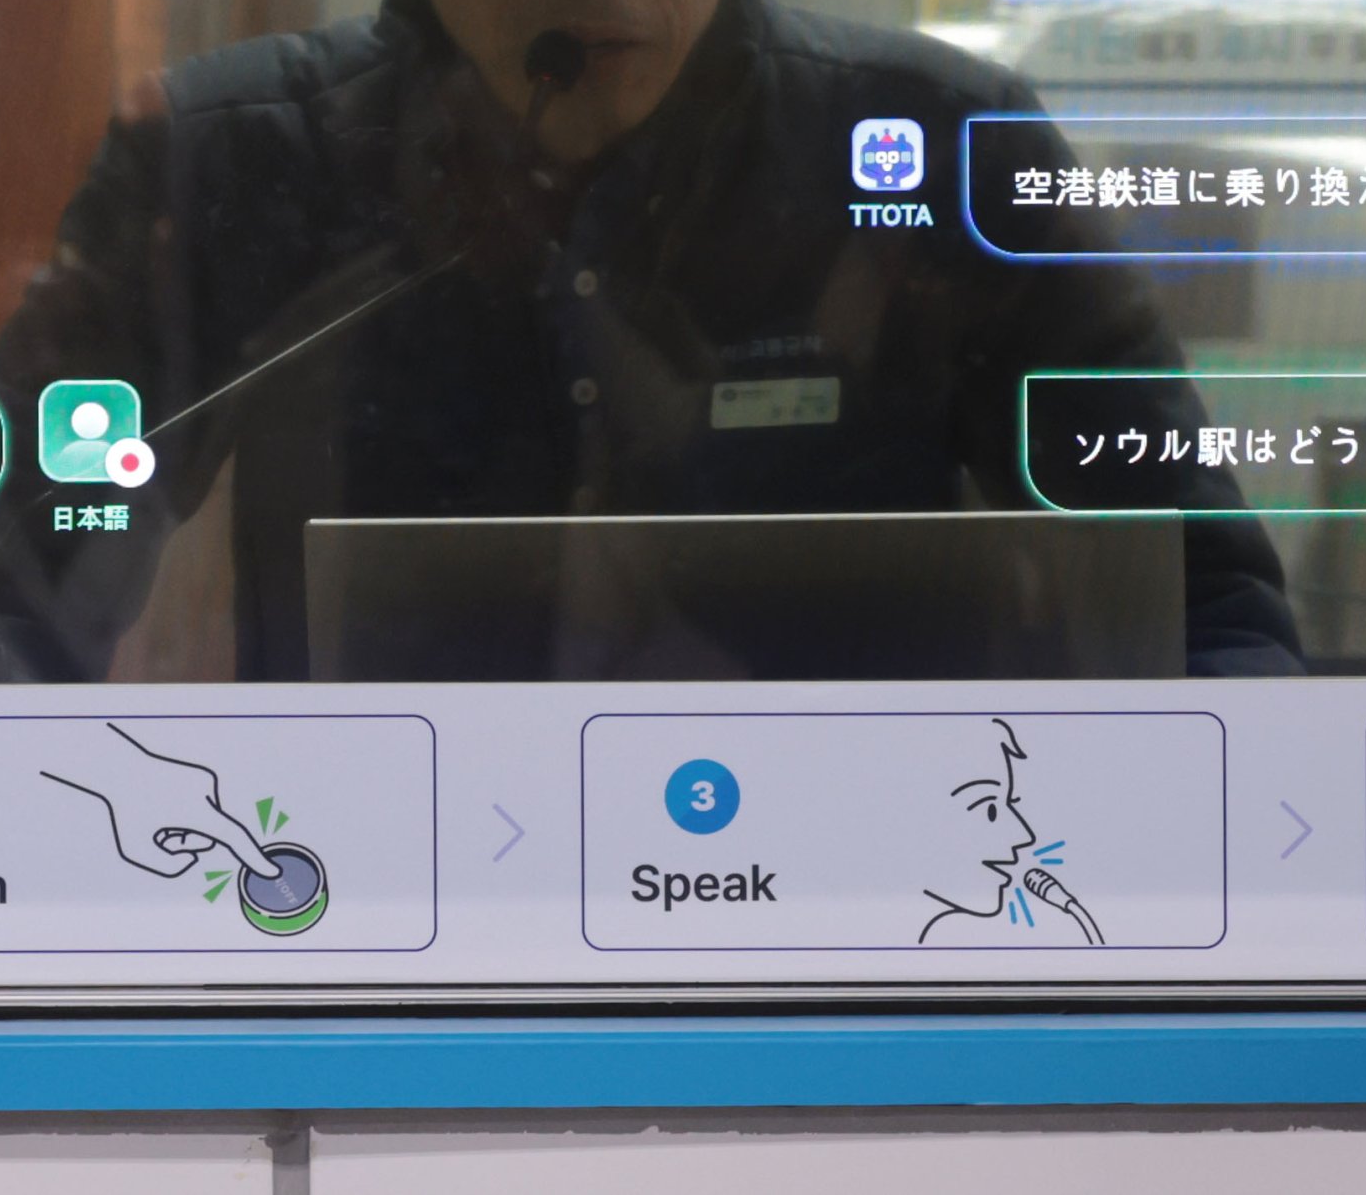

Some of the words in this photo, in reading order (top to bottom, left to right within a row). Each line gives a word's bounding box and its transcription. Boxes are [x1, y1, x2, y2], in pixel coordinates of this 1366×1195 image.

[849, 204, 933, 226] TTOTA
[55, 505, 129, 530] 日本語
[692, 781, 715, 811] 3
[632, 865, 776, 911] Speak
